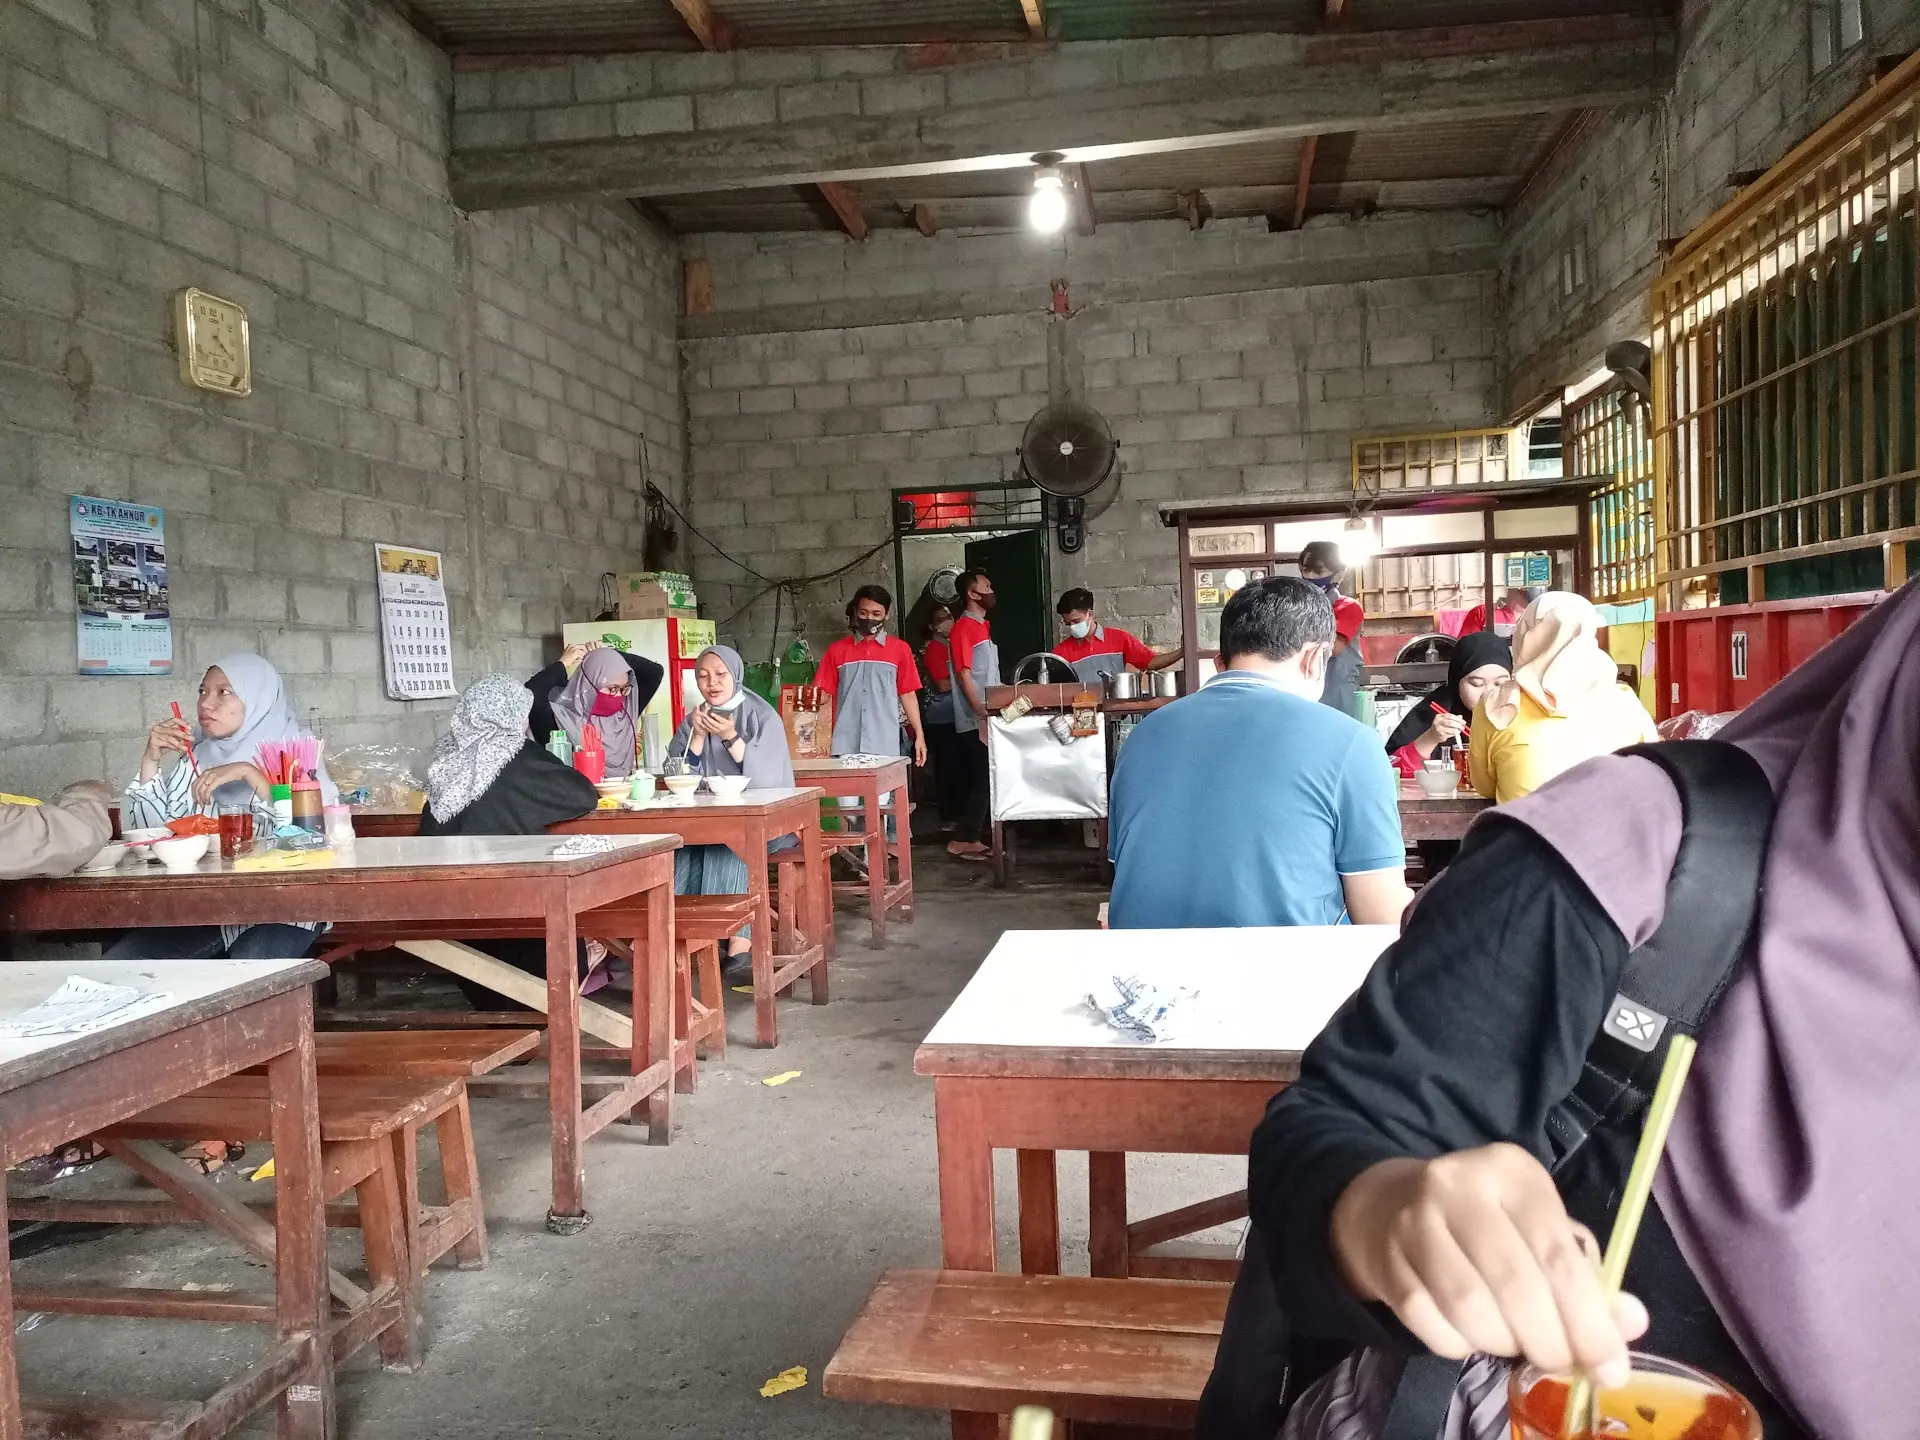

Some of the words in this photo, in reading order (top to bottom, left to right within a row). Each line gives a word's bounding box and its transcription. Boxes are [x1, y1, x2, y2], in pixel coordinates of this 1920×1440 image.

[407, 626, 412, 637] 5
[416, 626, 421, 638] 6
[440, 627, 445, 638] 9
[407, 644, 414, 656] 12
[416, 644, 423, 656] 13
[424, 644, 431, 656] 14
[432, 644, 439, 656] 15
[440, 645, 447, 656] 16
[603, 639, 632, 649] estea
[1732, 635, 1746, 676] 11
[417, 662, 424, 673] 20
[425, 662, 432, 673] 21
[433, 662, 440, 673] 22
[441, 662, 449, 673] 23
